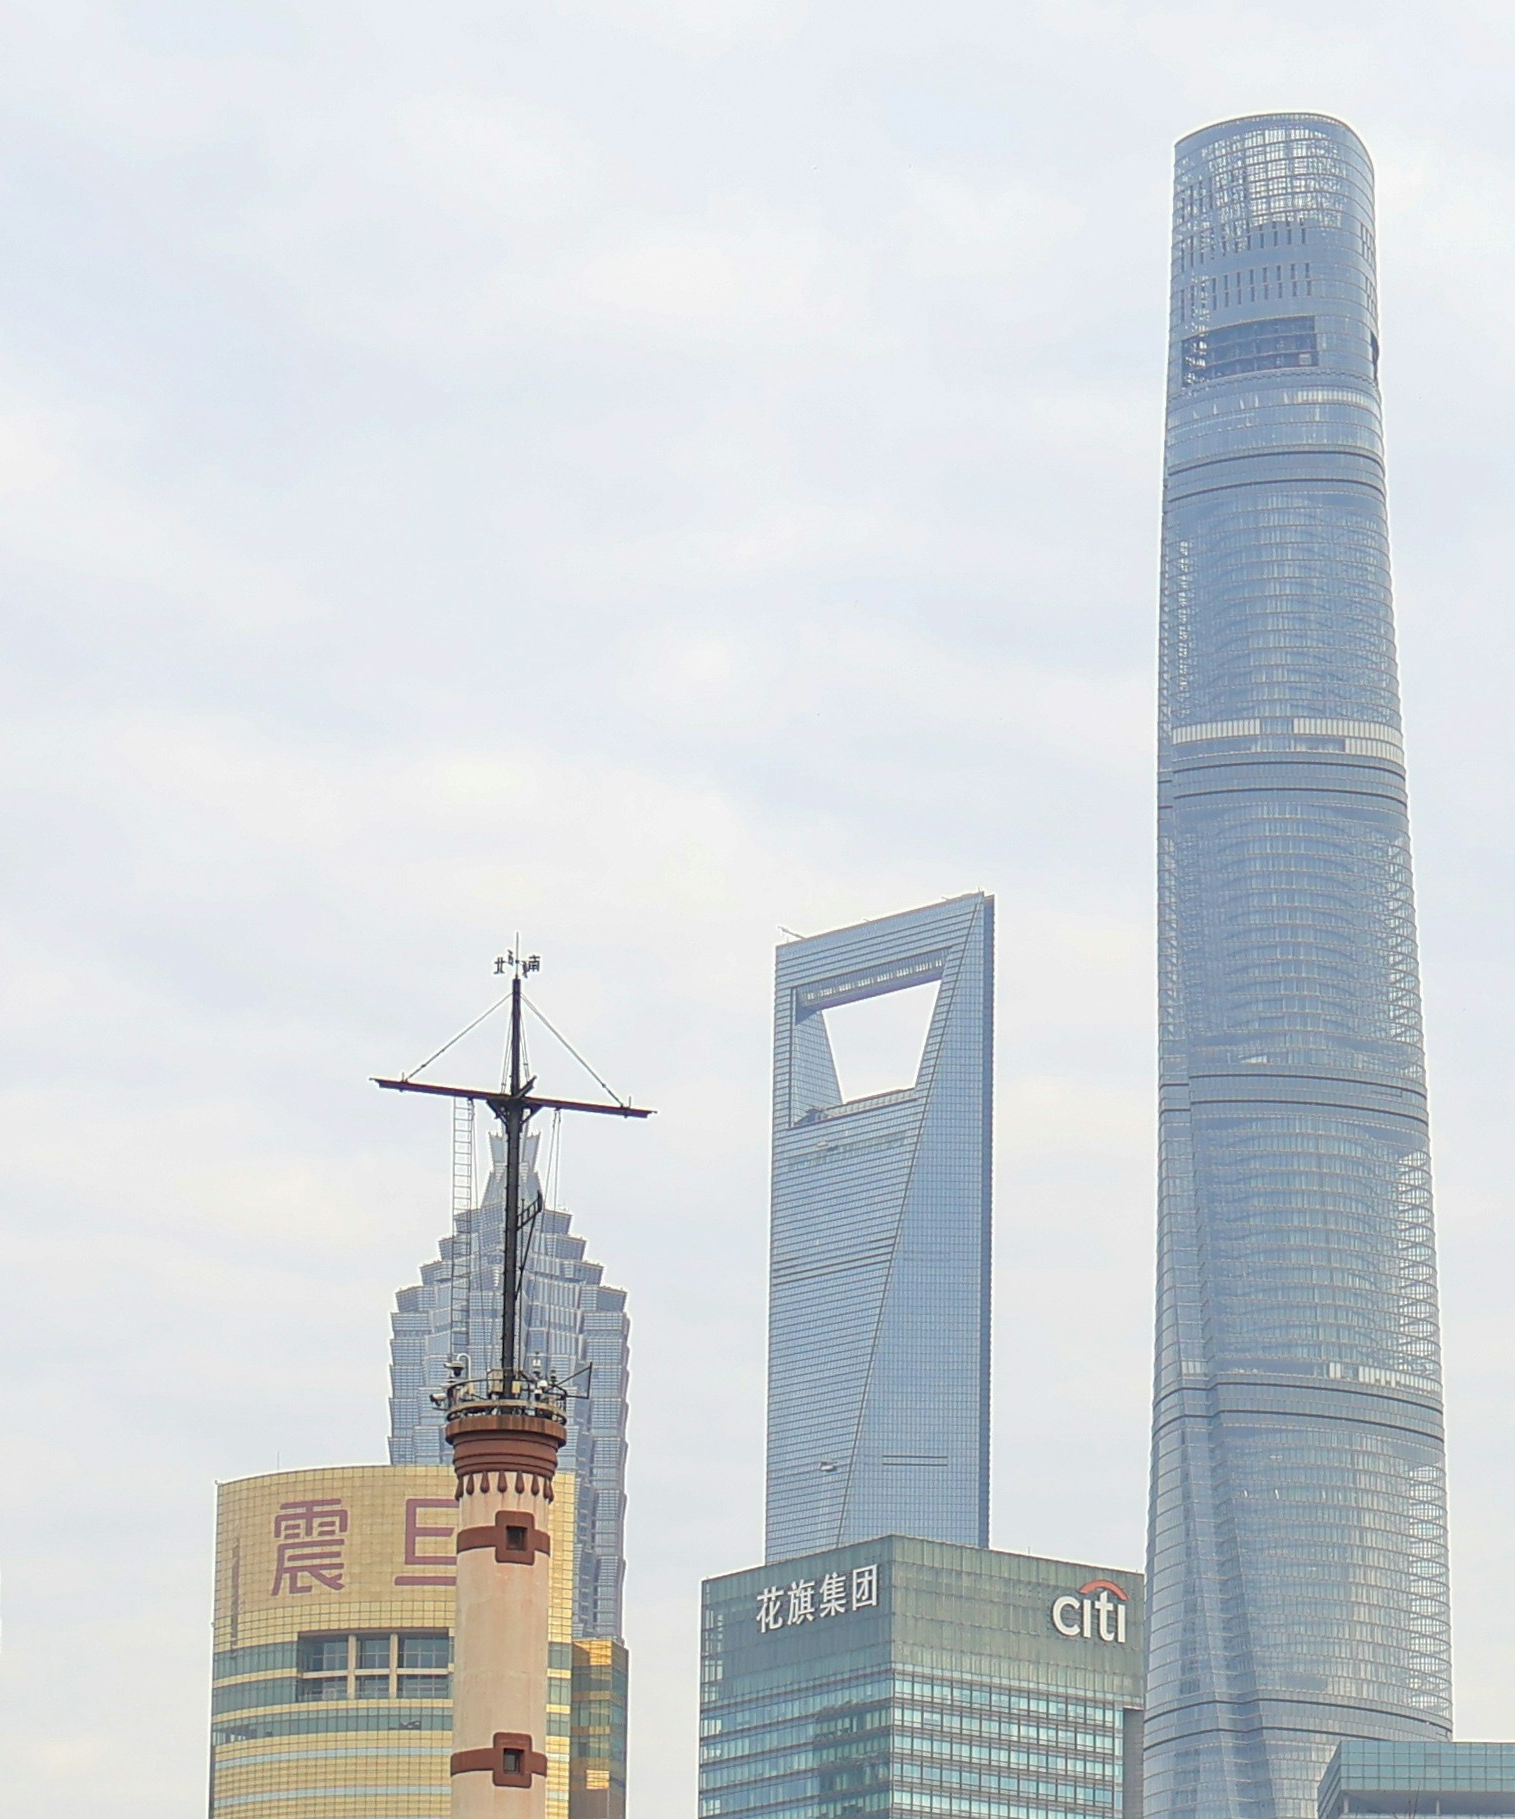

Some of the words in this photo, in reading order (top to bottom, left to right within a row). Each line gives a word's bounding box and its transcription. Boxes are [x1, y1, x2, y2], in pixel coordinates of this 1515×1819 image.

[271, 1498, 459, 1597] 震旦
[755, 1563, 878, 1633] 花旗集团
[1052, 1590, 1126, 1643] citi
